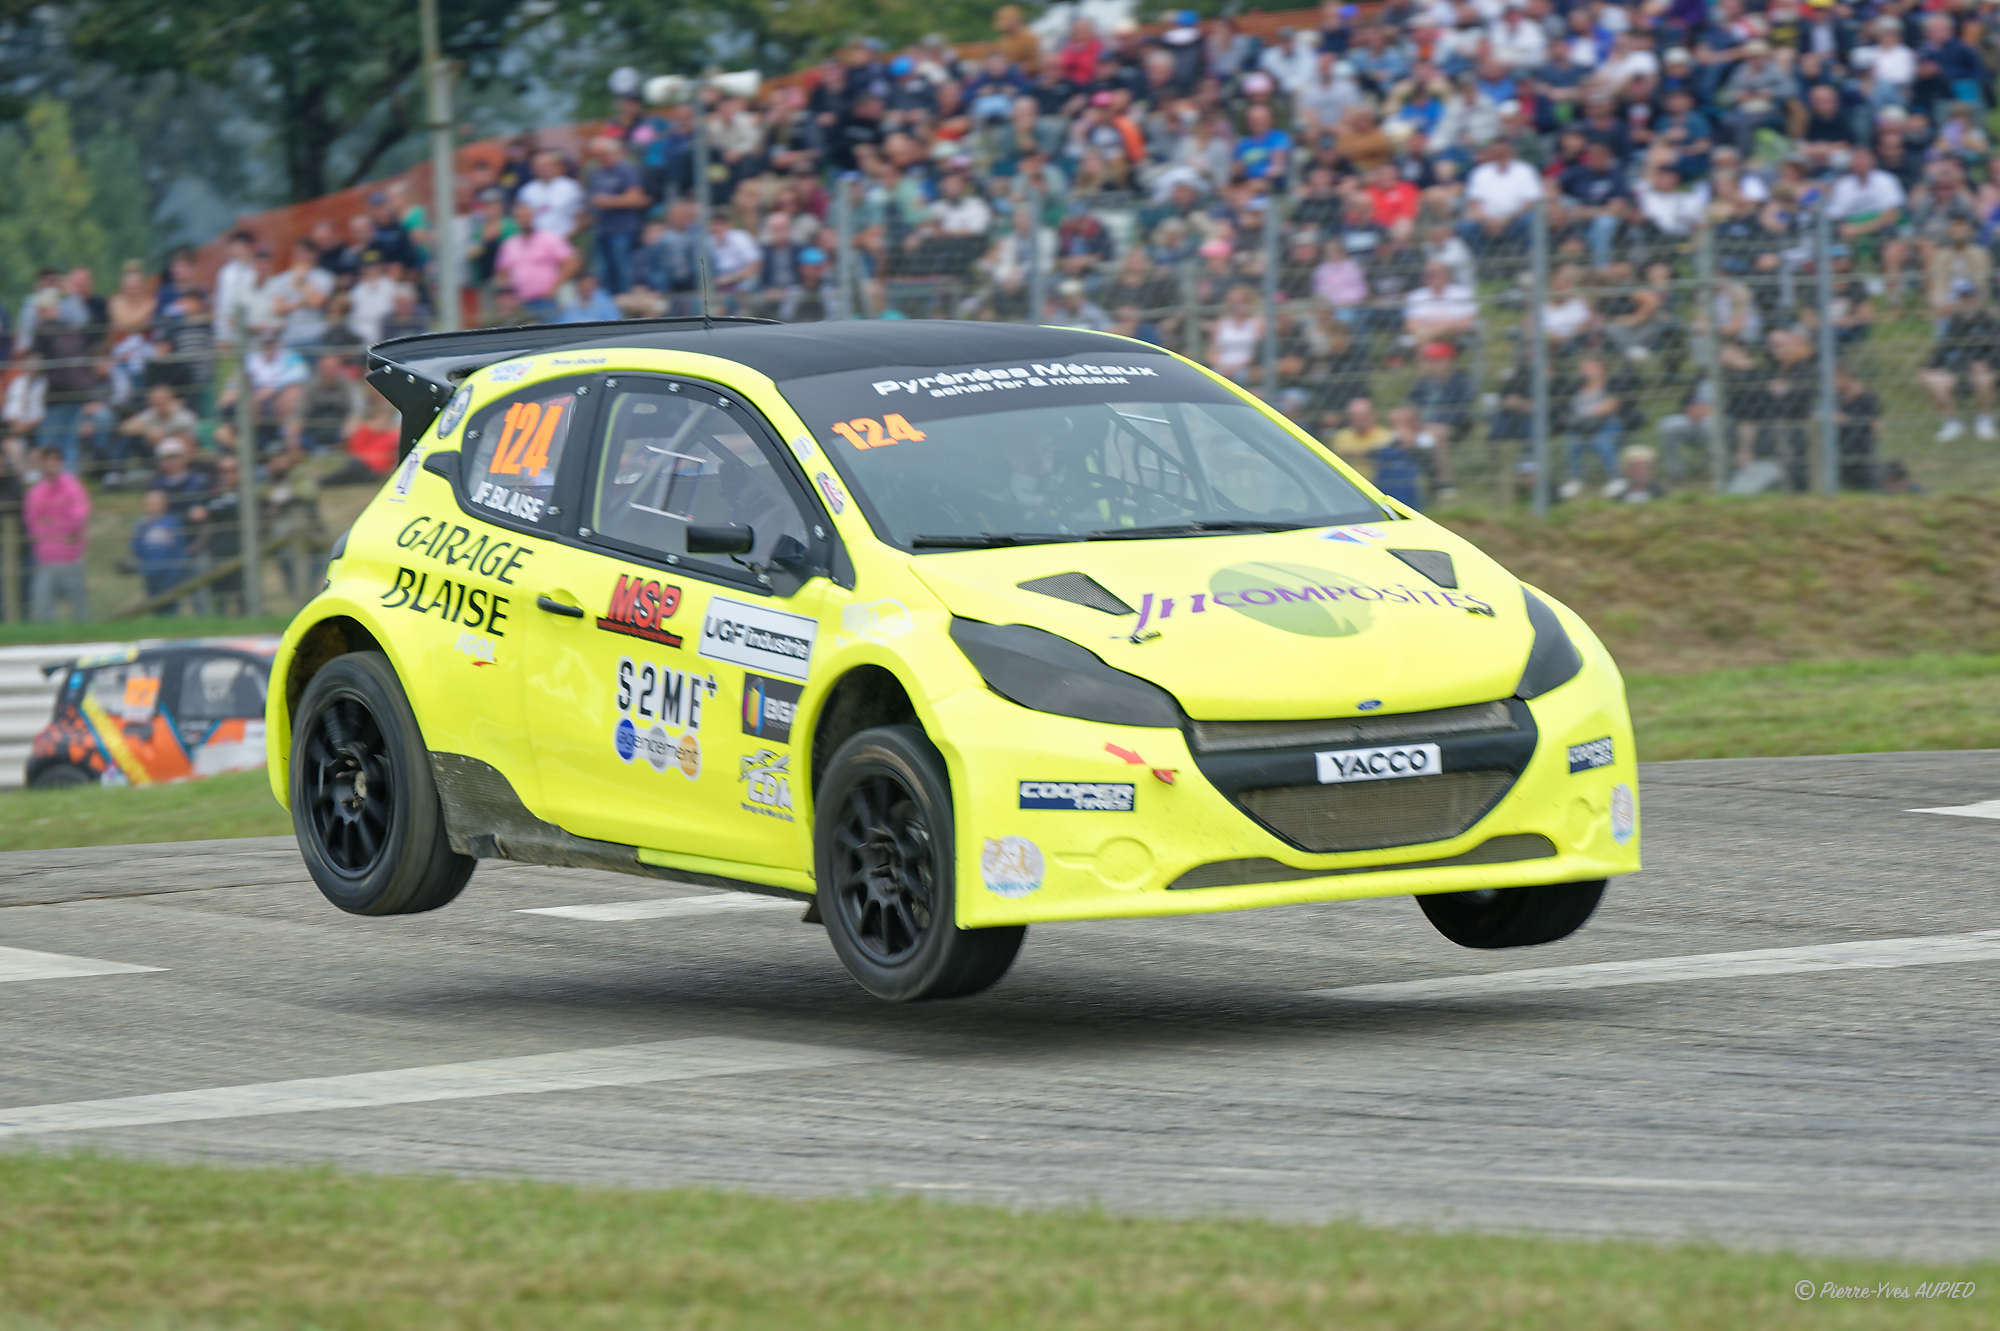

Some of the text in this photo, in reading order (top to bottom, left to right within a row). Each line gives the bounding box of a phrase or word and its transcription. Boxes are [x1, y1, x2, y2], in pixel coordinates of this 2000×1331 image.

[489, 402, 564, 477] 124
[832, 413, 928, 450] 124
[397, 516, 534, 585] GARAGE
[380, 566, 511, 637] BLAISE
[607, 573, 682, 632] MSP
[704, 615, 745, 645] UGF
[1331, 749, 1427, 777] YACCO
[1020, 782, 1135, 801] COOPER
